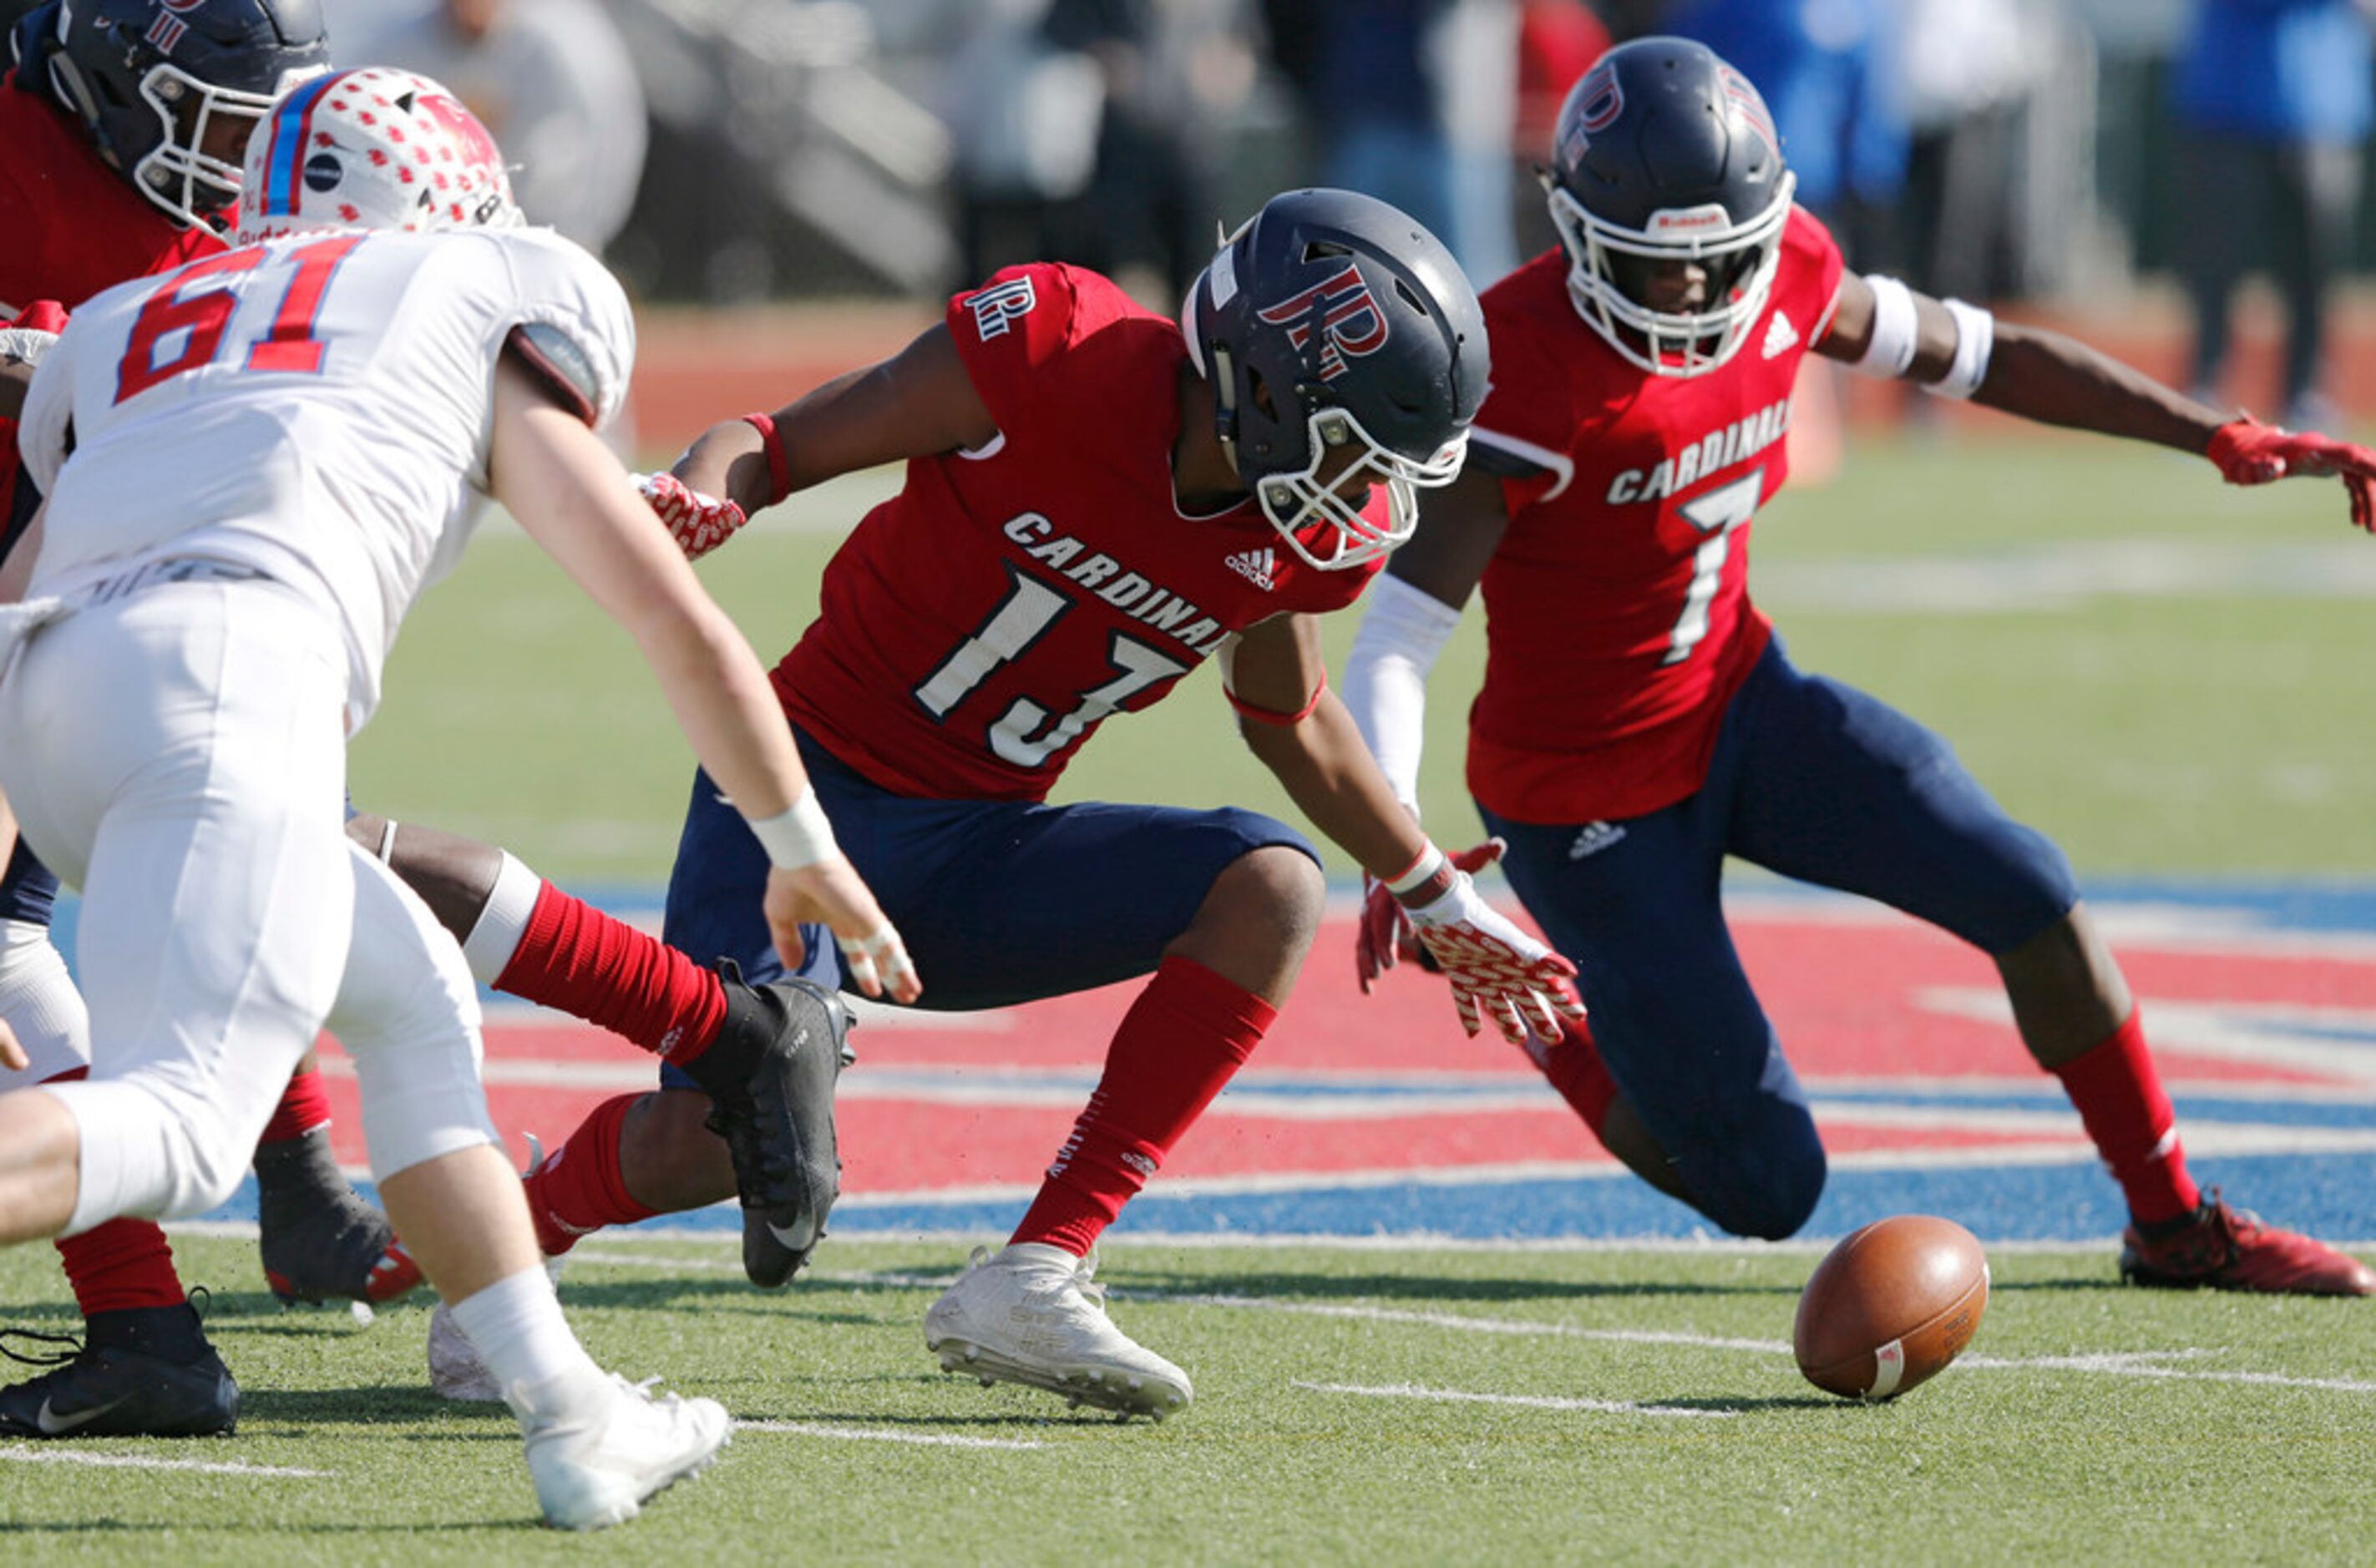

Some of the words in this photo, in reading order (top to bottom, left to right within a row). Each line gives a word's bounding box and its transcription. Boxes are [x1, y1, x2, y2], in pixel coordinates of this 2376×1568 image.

[112, 233, 369, 407] 61
[914, 555, 1193, 767] 13
[1661, 463, 1766, 666] 7
